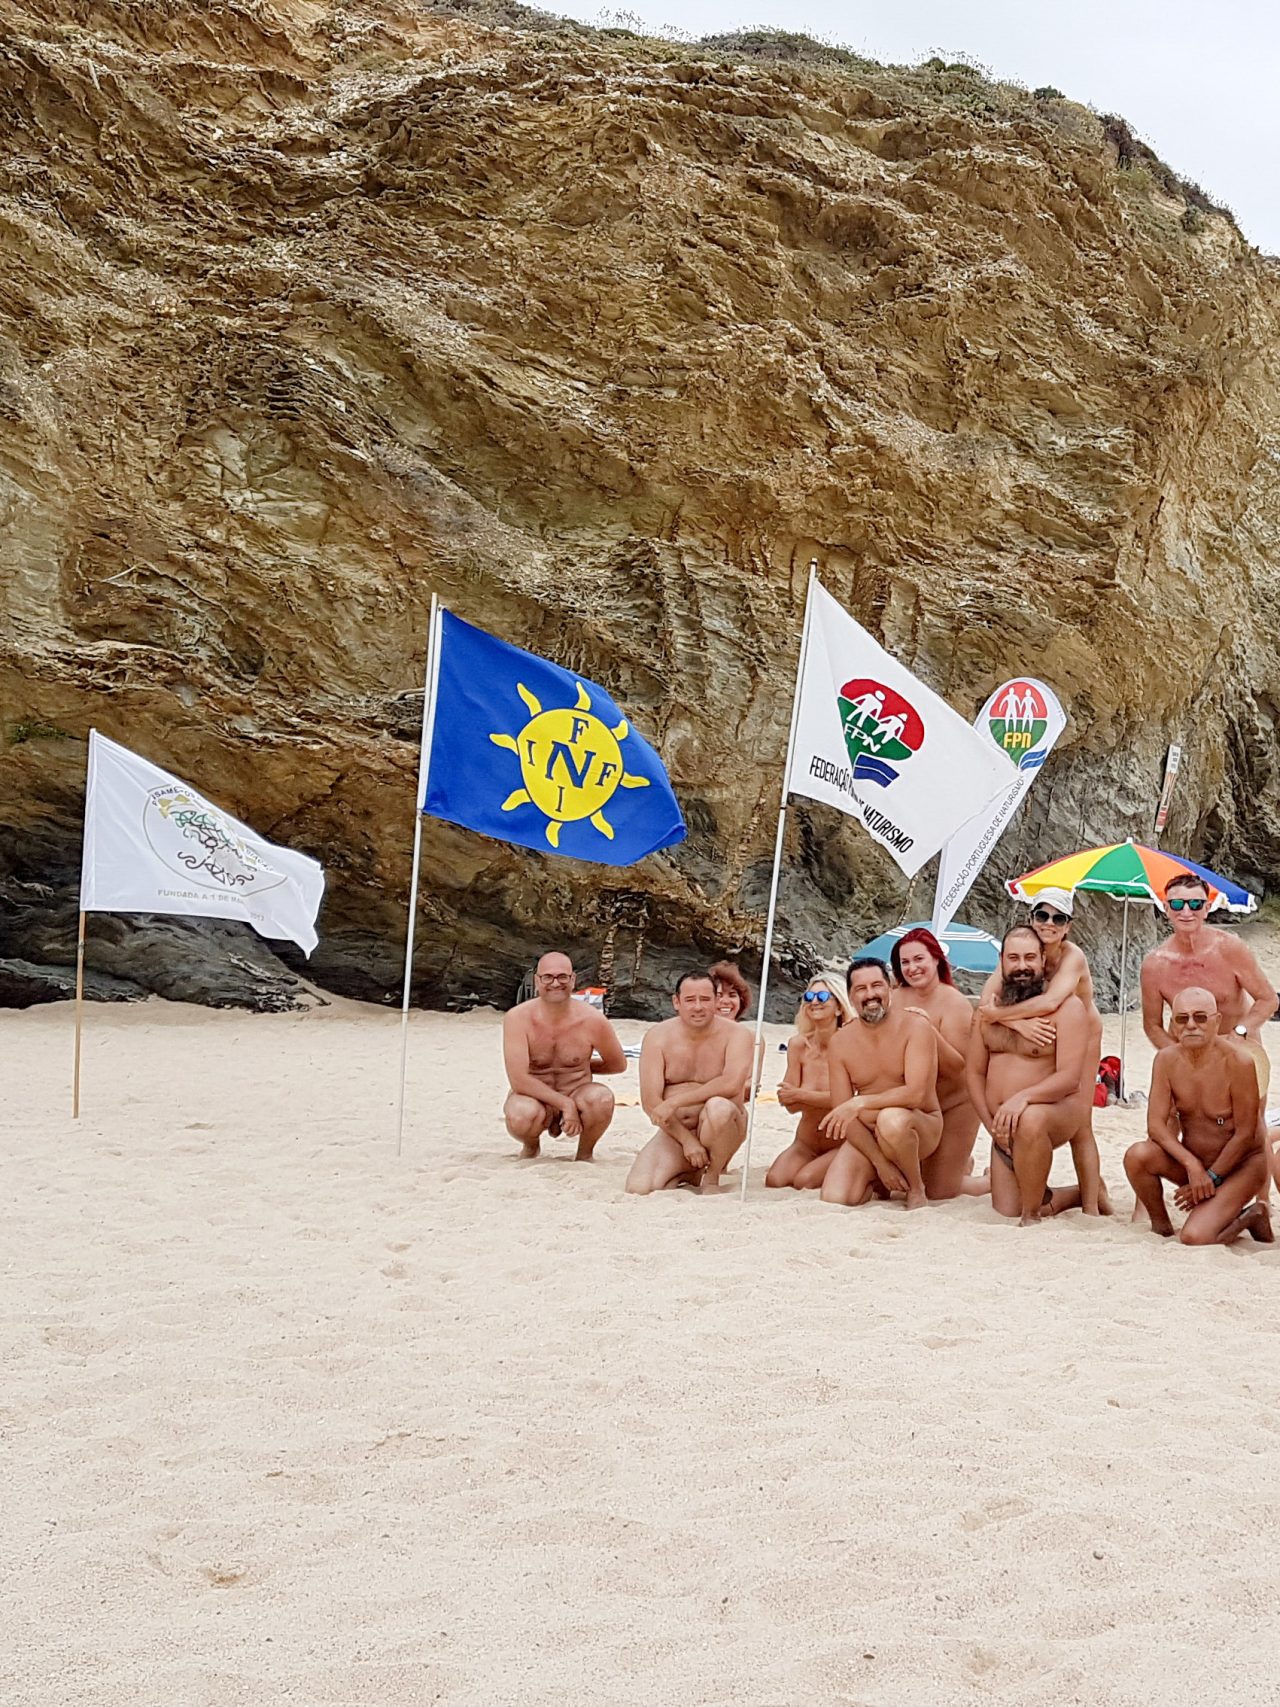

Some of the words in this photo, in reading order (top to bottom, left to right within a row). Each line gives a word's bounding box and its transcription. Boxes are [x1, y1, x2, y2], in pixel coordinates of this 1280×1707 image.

[844, 722, 881, 753] FPN
[863, 804, 914, 854] NATURISMO
[940, 871, 970, 912] FEDERAÇÃO
[967, 825, 995, 872] PORTUGUESA
[992, 815, 1002, 827] DE
[999, 778, 1025, 818] NATURISMO
